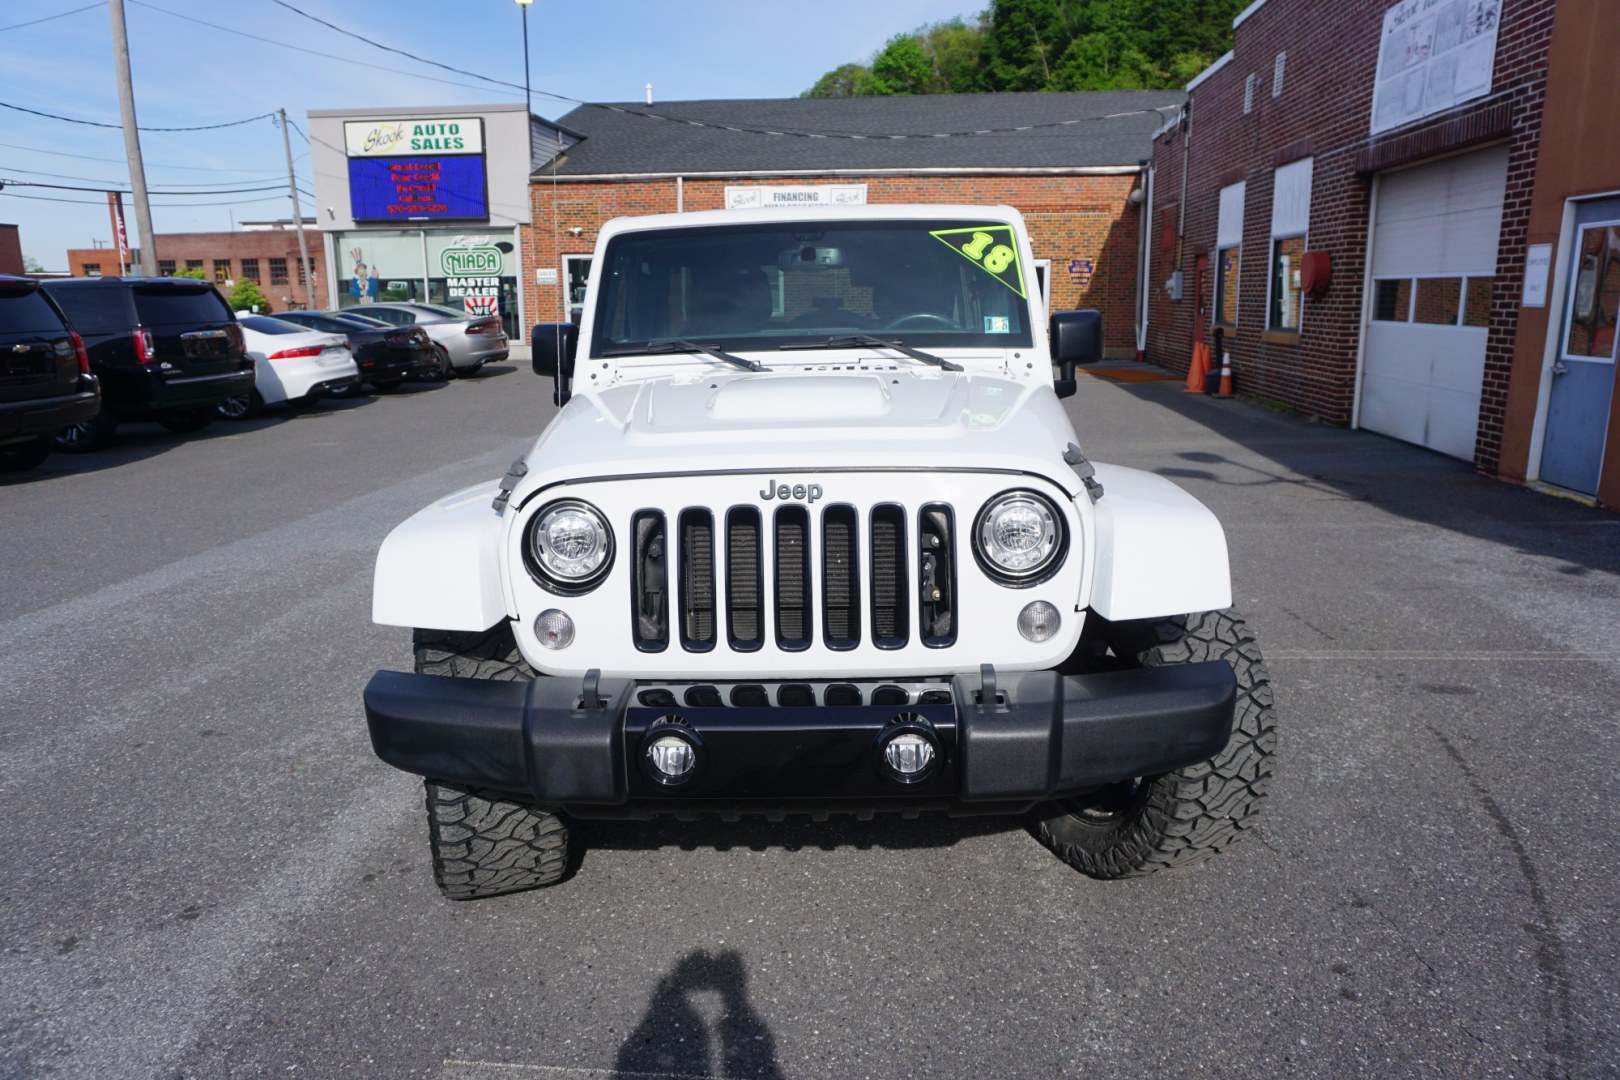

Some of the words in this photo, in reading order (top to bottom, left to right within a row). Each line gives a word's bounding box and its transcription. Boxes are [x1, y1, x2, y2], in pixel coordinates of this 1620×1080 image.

[413, 124, 459, 136] AUTO
[364, 123, 403, 152] Skook
[411, 137, 464, 150] SALES
[773, 192, 819, 202] FINANCING
[962, 231, 1015, 274] 18
[446, 253, 497, 269] NIADA
[447, 277, 499, 287] MASTER
[449, 287, 498, 297] DEALER
[472, 306, 491, 316] WE
[760, 479, 823, 503] Jeep
